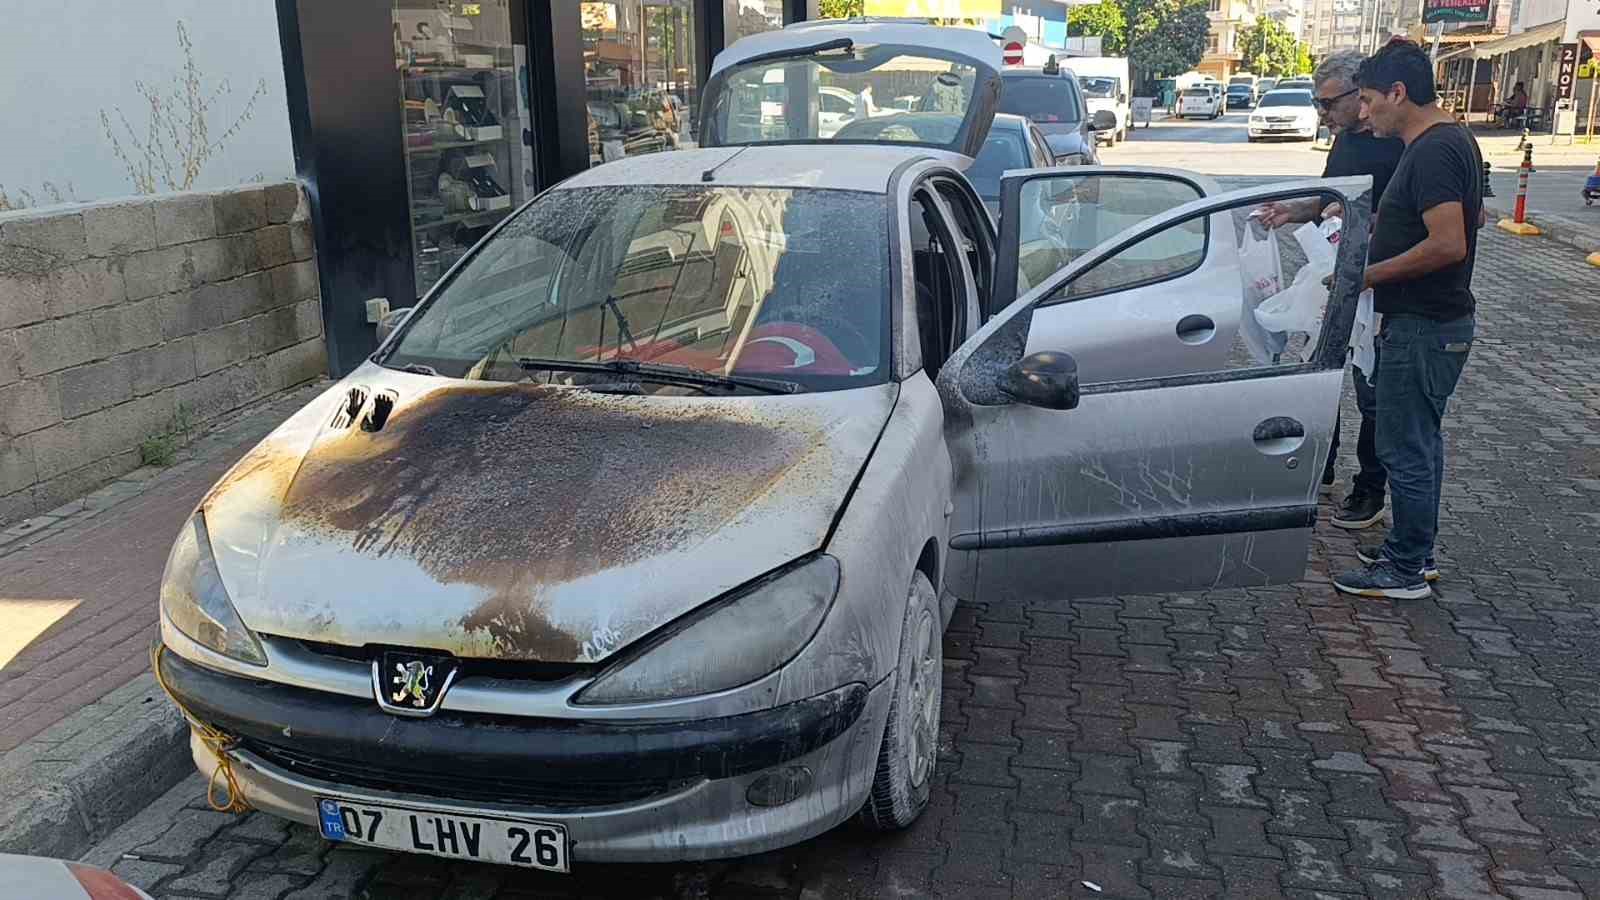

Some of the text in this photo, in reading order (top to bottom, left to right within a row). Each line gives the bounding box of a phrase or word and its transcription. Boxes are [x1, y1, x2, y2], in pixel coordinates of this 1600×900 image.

[1564, 50, 1574, 60] 2
[326, 822, 341, 834] TR
[340, 808, 557, 866] 07 LHV 26
